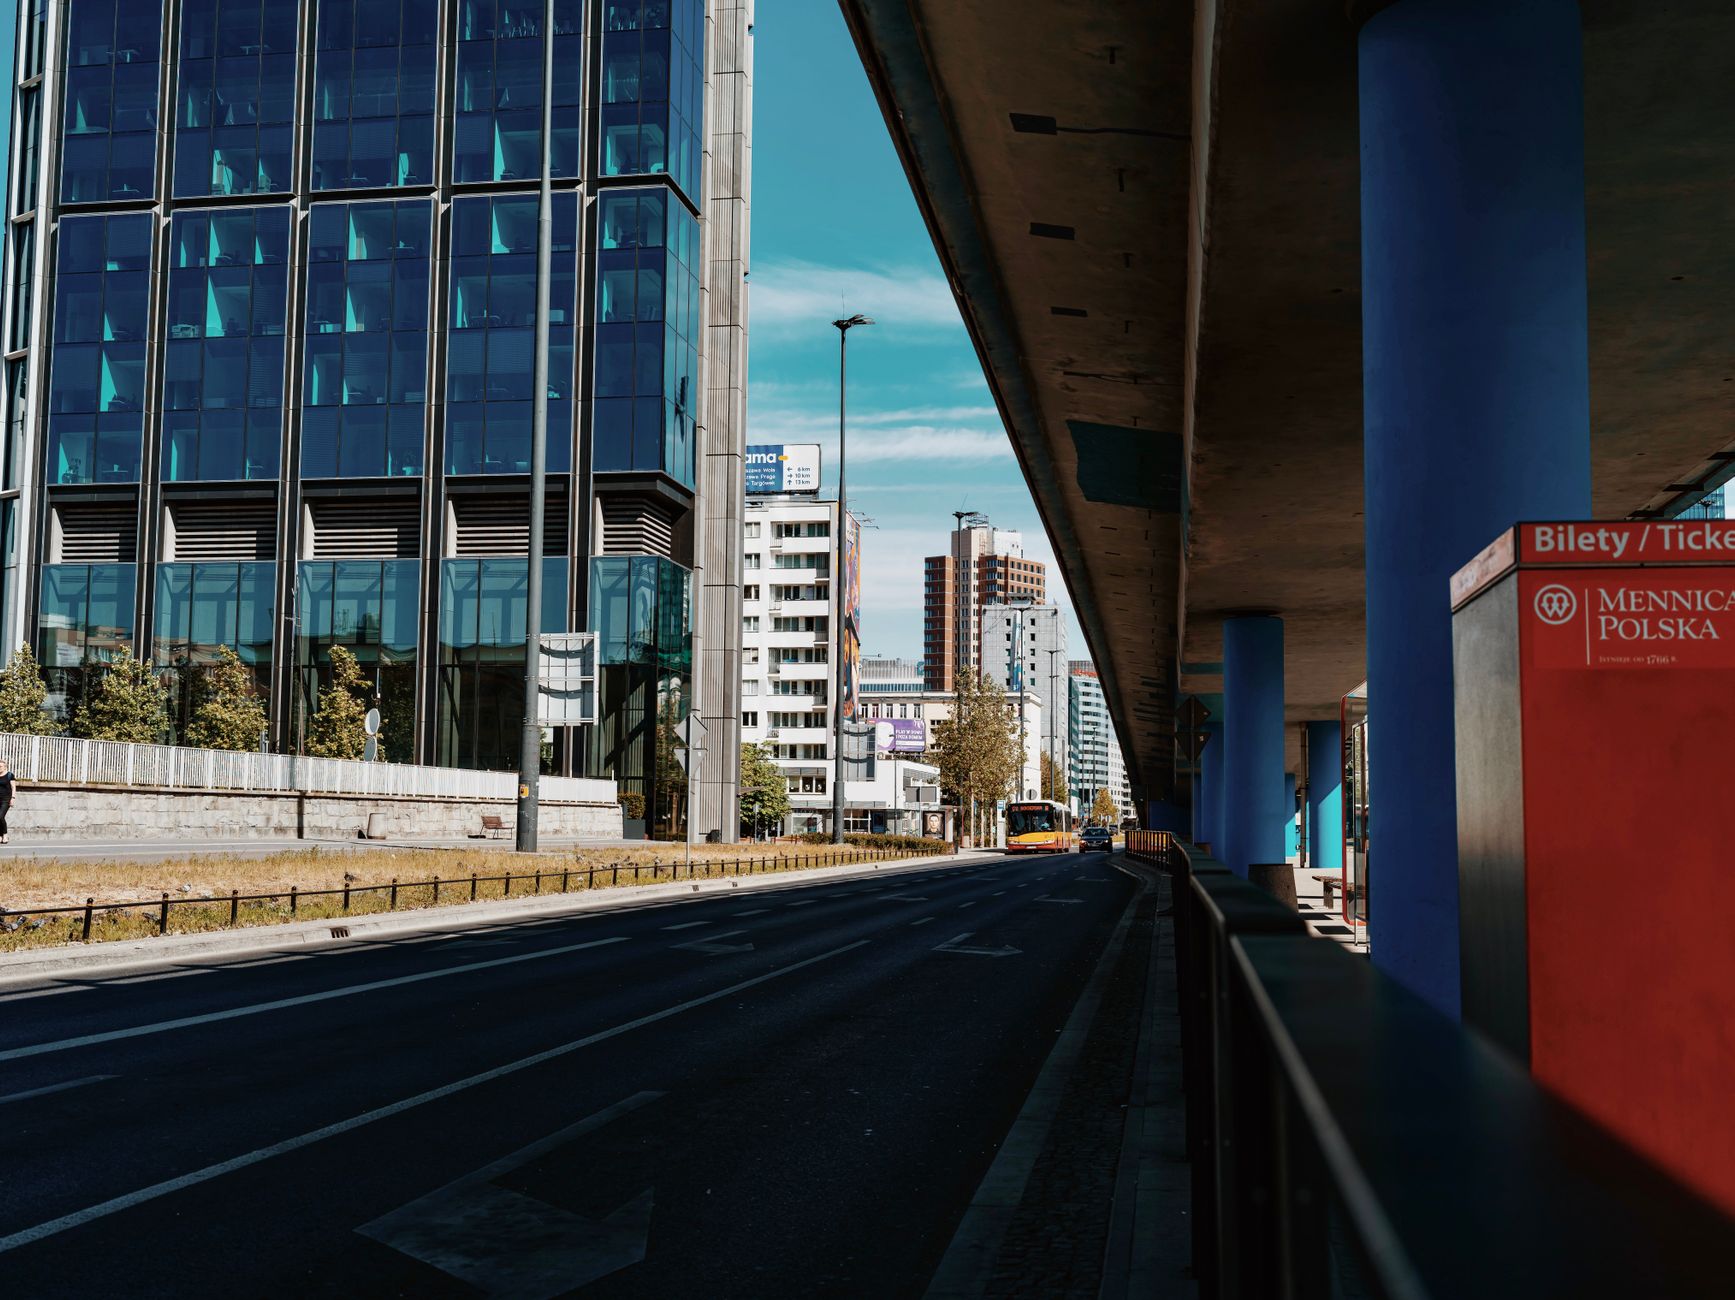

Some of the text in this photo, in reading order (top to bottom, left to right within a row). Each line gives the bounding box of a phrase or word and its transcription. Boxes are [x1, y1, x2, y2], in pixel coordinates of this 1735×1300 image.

[1535, 523, 1735, 559] Bilety / Ticke
[1598, 588, 1735, 612] MENNICA
[1598, 616, 1720, 640] POLSKA
[1647, 654, 1669, 665] 1766
